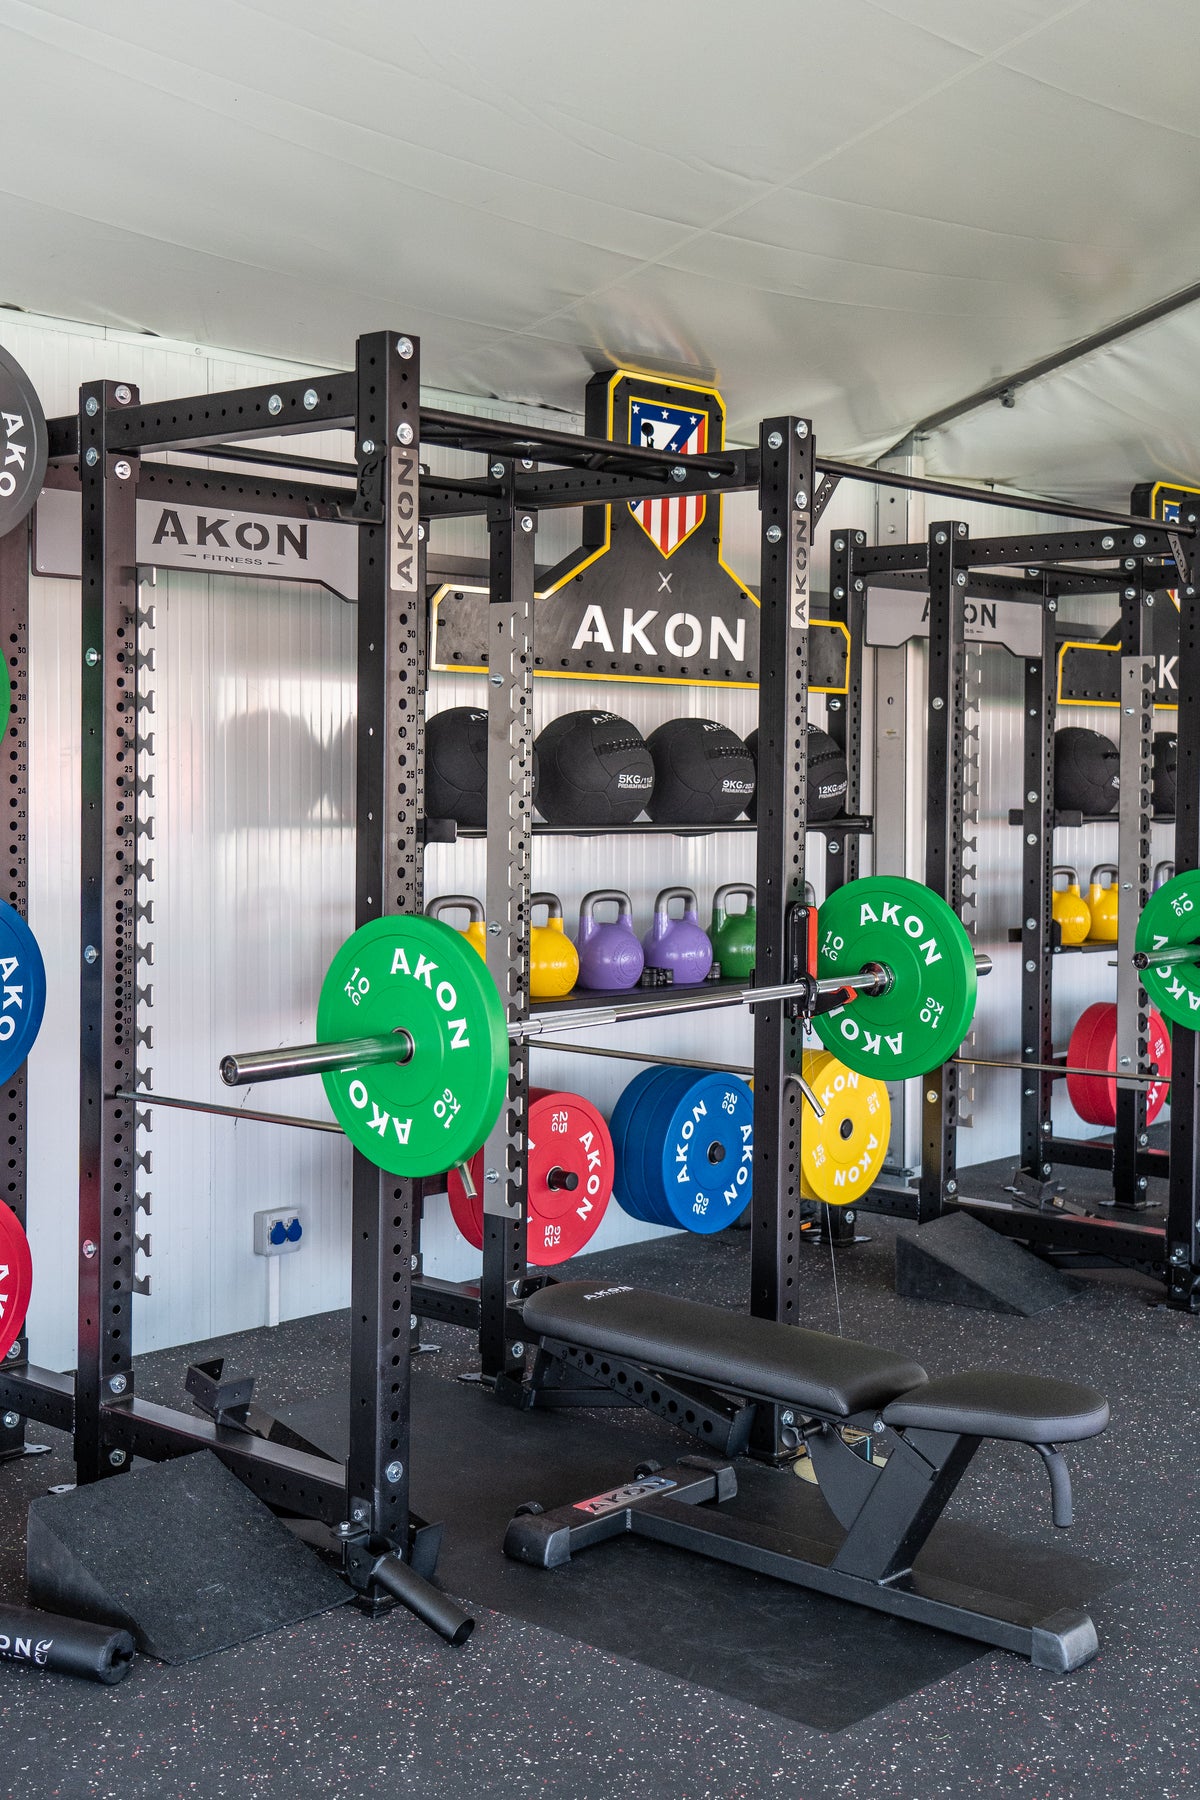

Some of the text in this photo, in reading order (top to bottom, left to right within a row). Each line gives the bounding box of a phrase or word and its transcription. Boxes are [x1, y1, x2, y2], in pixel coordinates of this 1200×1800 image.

[397, 458, 414, 584] AKON
[152, 508, 308, 560] AKON
[203, 553, 263, 565] FITNESS
[658, 571, 673, 593] X
[795, 520, 807, 623] AKON
[407, 602, 416, 610] 31
[407, 630, 416, 638] 30
[571, 604, 746, 662] AKON
[407, 658, 416, 666] 29
[407, 686, 415, 694] 28
[406, 715, 415, 723] 27
[406, 742, 415, 750] 26
[406, 770, 415, 778] 25
[406, 798, 414, 806] 24
[406, 826, 414, 835] 23
[405, 855, 414, 863] 22
[1170, 898, 1184, 917] KG
[1178, 892, 1194, 912] 10
[825, 930, 844, 950] 10
[860, 902, 943, 966] AKON
[820, 944, 839, 961] KG
[351, 967, 370, 994] 10
[344, 981, 361, 1006] KG
[390, 948, 470, 1050] AKON
[925, 997, 945, 1015] KG
[919, 1008, 940, 1029] 10
[340, 1067, 413, 1144] AKO
[442, 1088, 461, 1114] KG
[721, 1091, 731, 1109] KG
[727, 1092, 738, 1115] 20
[433, 1100, 454, 1129] 10
[551, 1113, 559, 1132] KG
[559, 1111, 568, 1134] 25
[676, 1100, 707, 1183] AKON
[812, 1143, 824, 1160] 15
[723, 1124, 753, 1206] AKON
[834, 1133, 878, 1187] AKON
[576, 1131, 602, 1221] AKON
[692, 1192, 704, 1215] 20
[700, 1197, 709, 1215] KG
[544, 1224, 554, 1247] 25
[553, 1225, 561, 1244] KG
[589, 1480, 667, 1511] AKON
